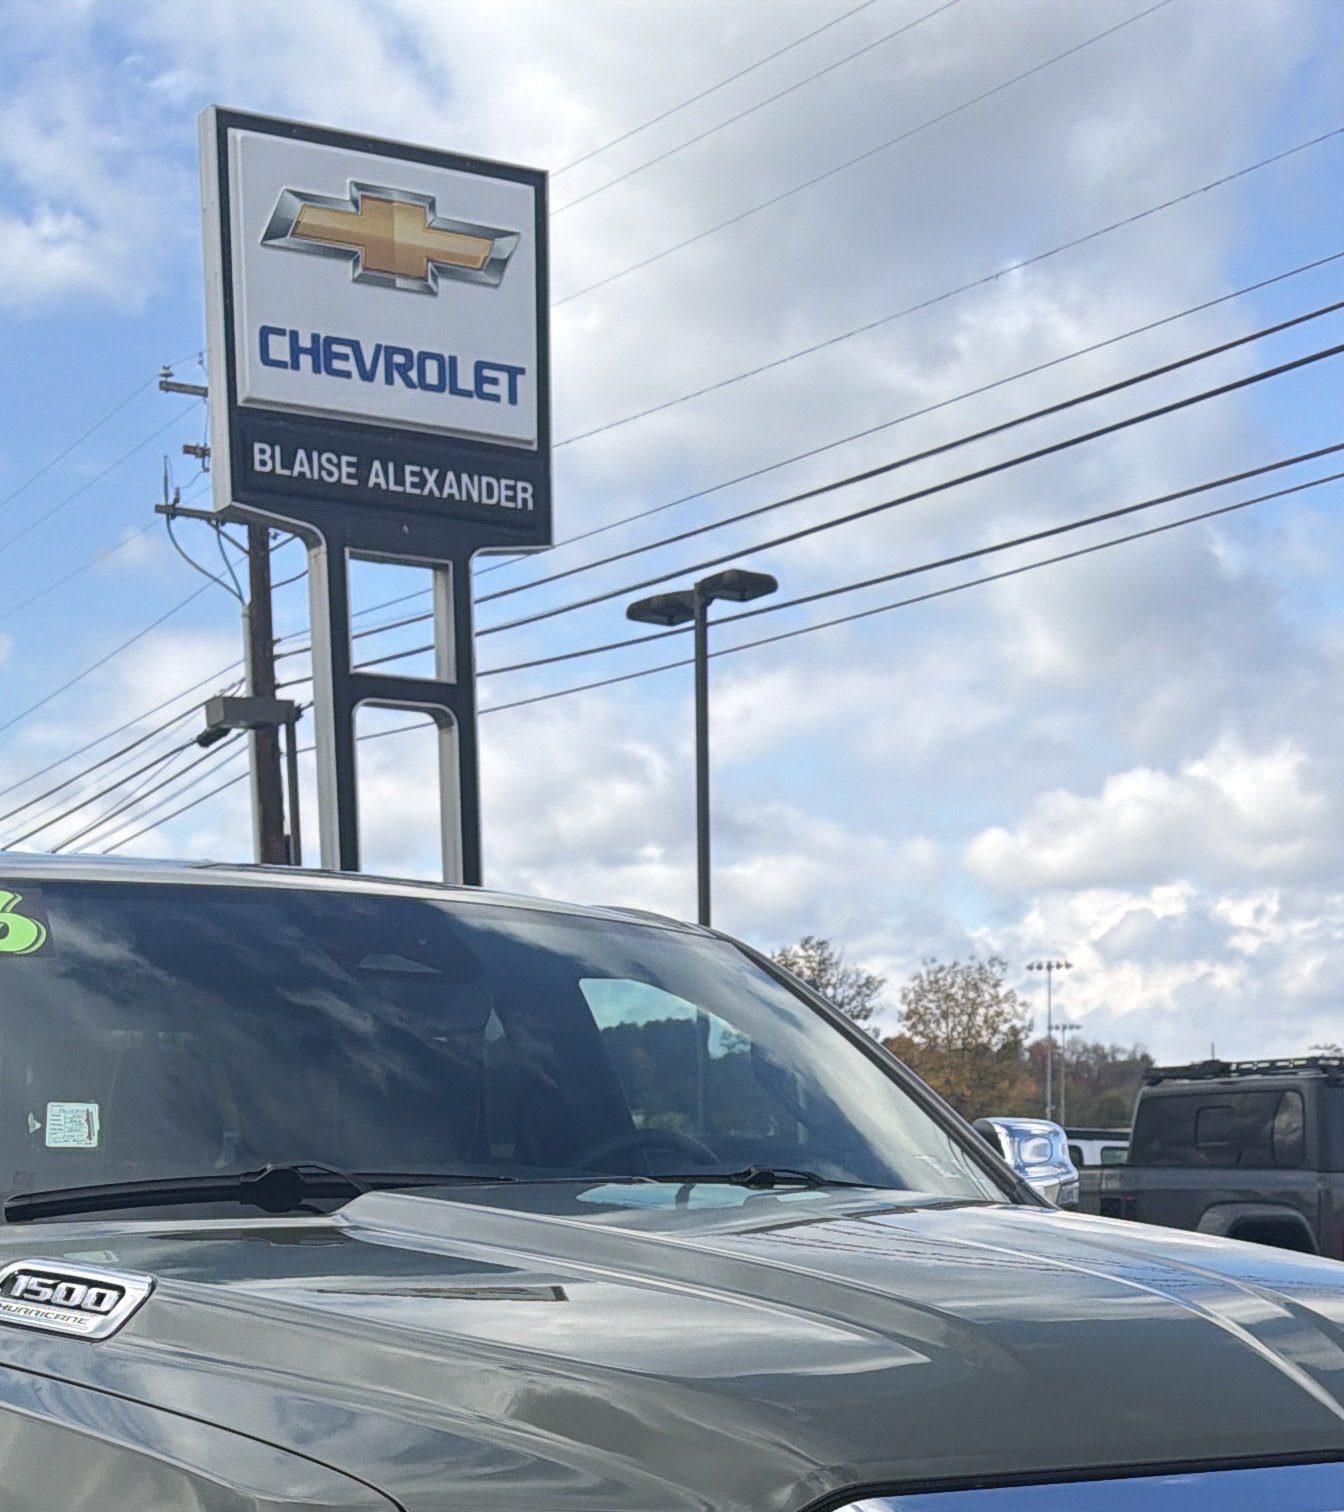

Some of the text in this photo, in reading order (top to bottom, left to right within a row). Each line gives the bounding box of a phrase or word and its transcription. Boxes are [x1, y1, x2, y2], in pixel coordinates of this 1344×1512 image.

[258, 325, 526, 405] CHEVROLET
[253, 442, 534, 511] BLAISE ALEXANDER
[9, 1274, 119, 1312] 1500
